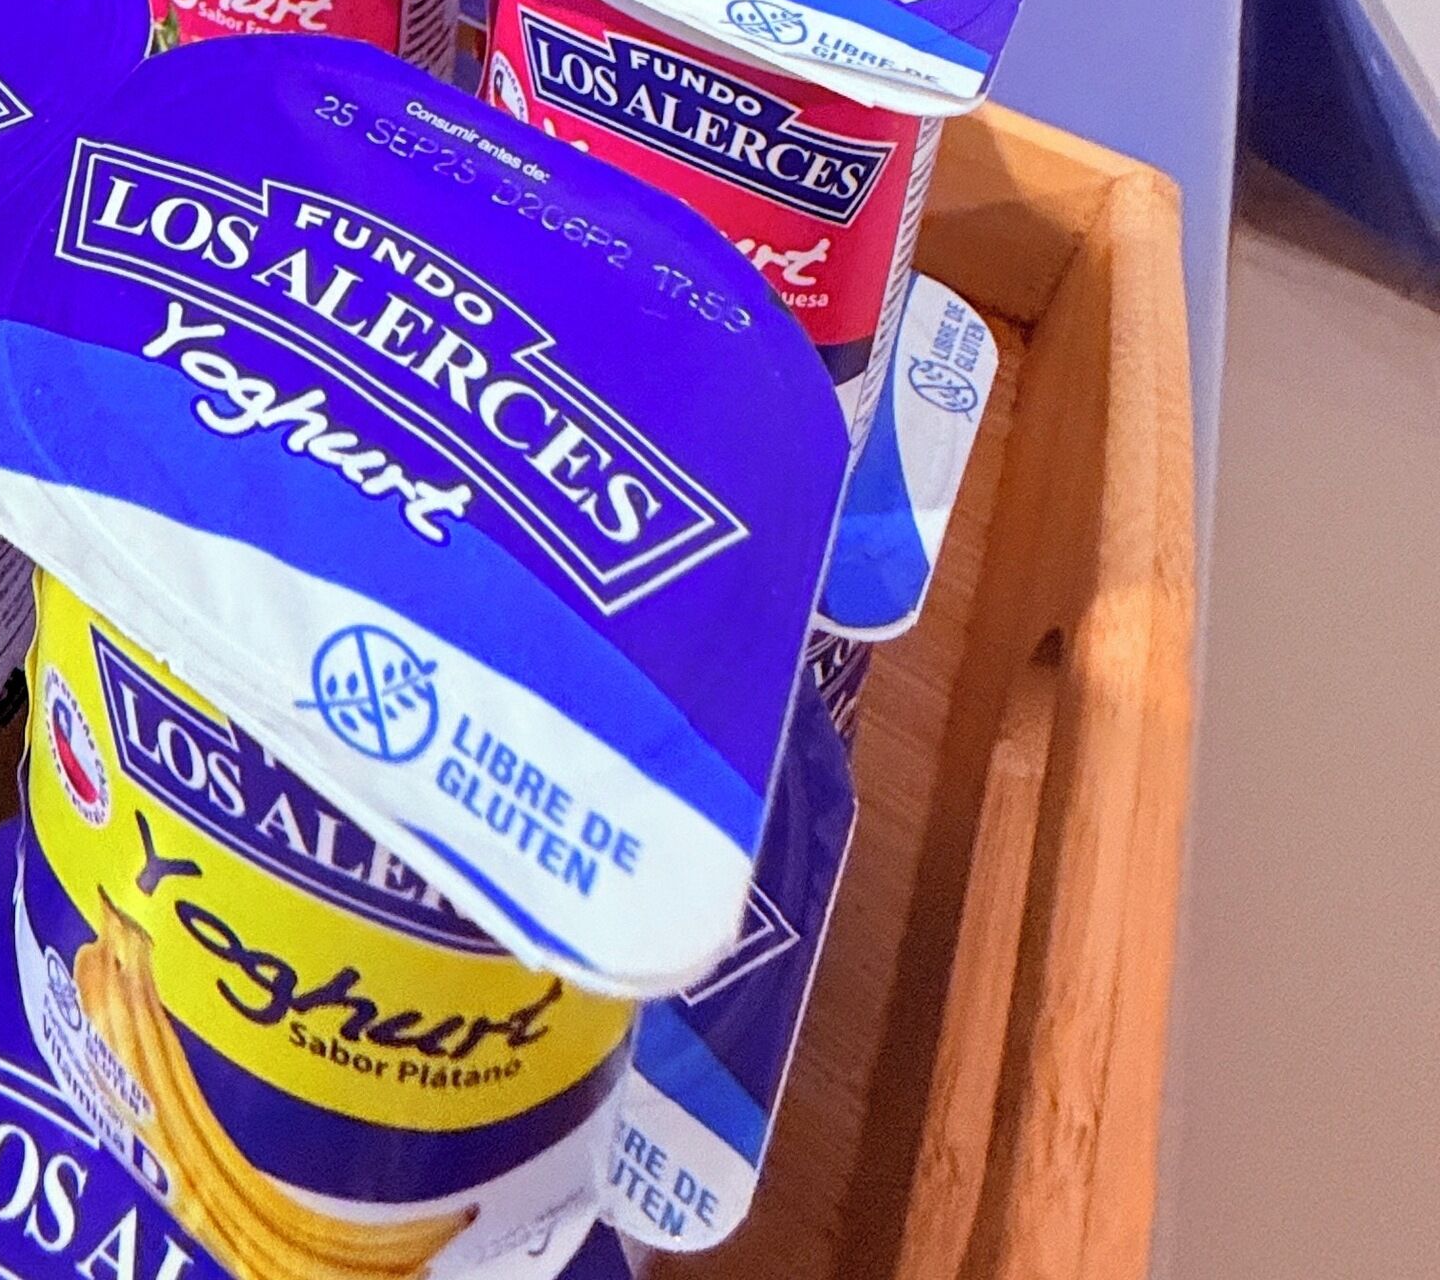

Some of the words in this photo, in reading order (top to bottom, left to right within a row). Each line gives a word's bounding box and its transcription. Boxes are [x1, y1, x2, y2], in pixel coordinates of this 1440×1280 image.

[198, 1, 244, 31] Sabor
[817, 32, 895, 68] LIBRE
[314, 95, 359, 128] 25
[366, 117, 477, 185] SEP25
[405, 101, 479, 146] Consumir
[477, 137, 523, 172] antes
[522, 160, 551, 184] de:
[537, 42, 620, 108] LOS
[623, 84, 868, 204] ALERCES
[630, 49, 762, 117] FUNDO
[296, 203, 495, 325] FUNDO
[92, 174, 262, 271] LOS
[252, 248, 662, 546] ALERCES
[140, 301, 473, 546] Yoghurt
[118, 679, 245, 818] LOS
[450, 713, 575, 824] LIBRE
[581, 810, 642, 875] DE
[435, 760, 604, 898] GLUTEN
[134, 809, 563, 1059] Yoghurt
[288, 1021, 390, 1080] Sabor
[396, 1055, 523, 1088] Plátano
[672, 1167, 719, 1228] DE
